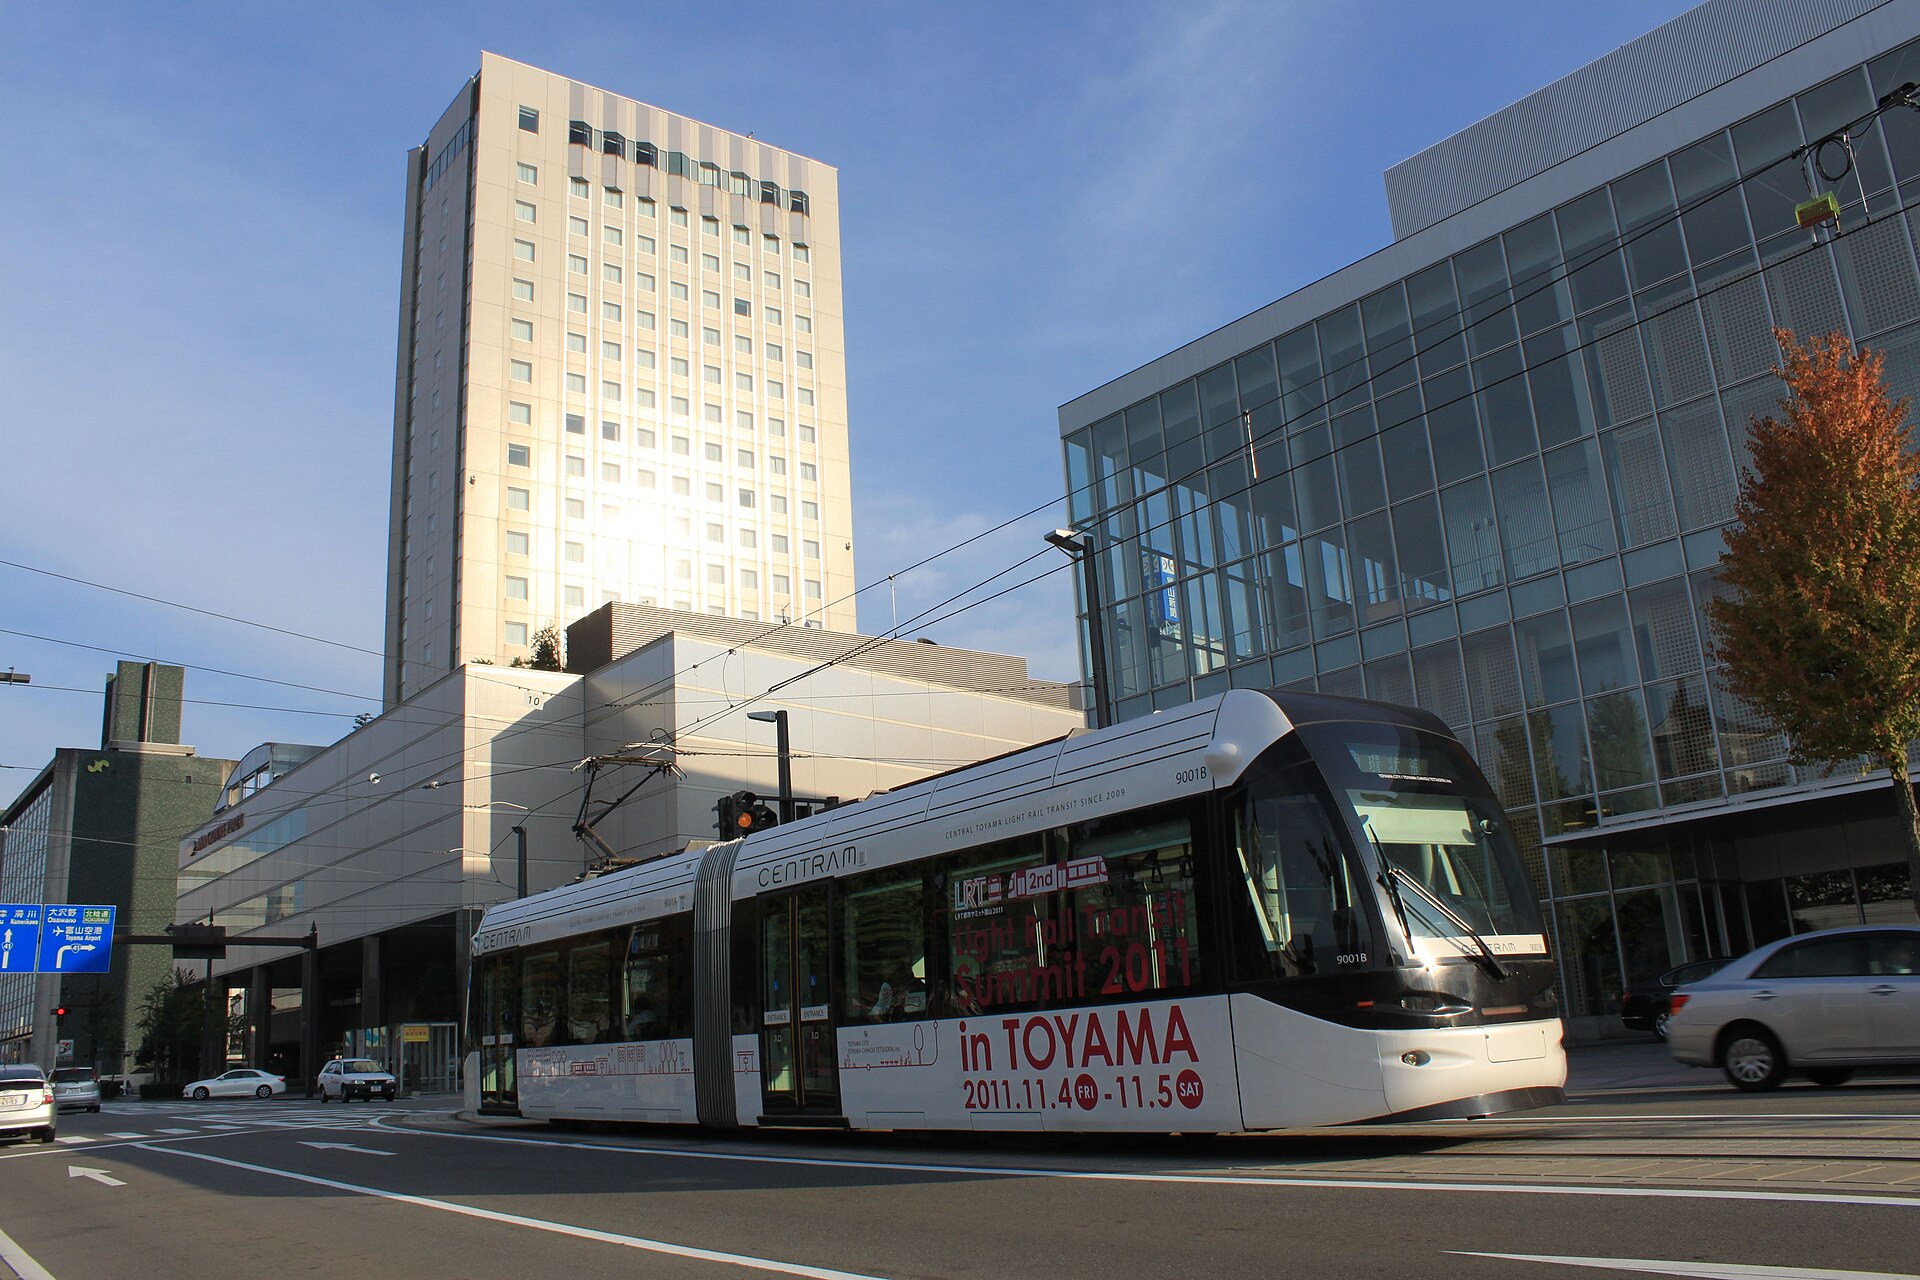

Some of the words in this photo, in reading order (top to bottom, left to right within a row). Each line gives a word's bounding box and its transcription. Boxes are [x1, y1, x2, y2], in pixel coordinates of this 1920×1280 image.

[1175, 766, 1208, 785] 9001B
[945, 825, 974, 840] CENTRAL
[975, 819, 1003, 832] TOYAMA
[1004, 813, 1025, 826] LIGHT
[1027, 809, 1044, 820] RAIL
[1046, 801, 1078, 816] TRANSIT
[1080, 794, 1103, 807] SINCE
[1106, 788, 1126, 800] 2009
[758, 845, 857, 887] CENTRAM
[1029, 869, 1053, 890] 2nd
[48, 908, 77, 917] 大沢野
[65, 926, 103, 935] 富山空港
[955, 916, 1015, 961] Light
[1025, 908, 1074, 949] Rail
[1081, 890, 1186, 939] Transit
[482, 925, 531, 950] CENTRAM
[1461, 942, 1517, 954] CETRAM
[1336, 952, 1367, 965] 9001B
[955, 951, 1087, 1008] Summit
[1101, 936, 1191, 994] 2011
[767, 1013, 787, 1022] ENTRANCE
[803, 1009, 824, 1018] ENTRANCE
[959, 1020, 992, 1071] in
[1002, 1005, 1200, 1071] TOYAMA
[963, 1077, 1072, 1110] 2011.11.4
[1077, 1085, 1095, 1099] FRI
[1179, 1082, 1201, 1097] SAT
